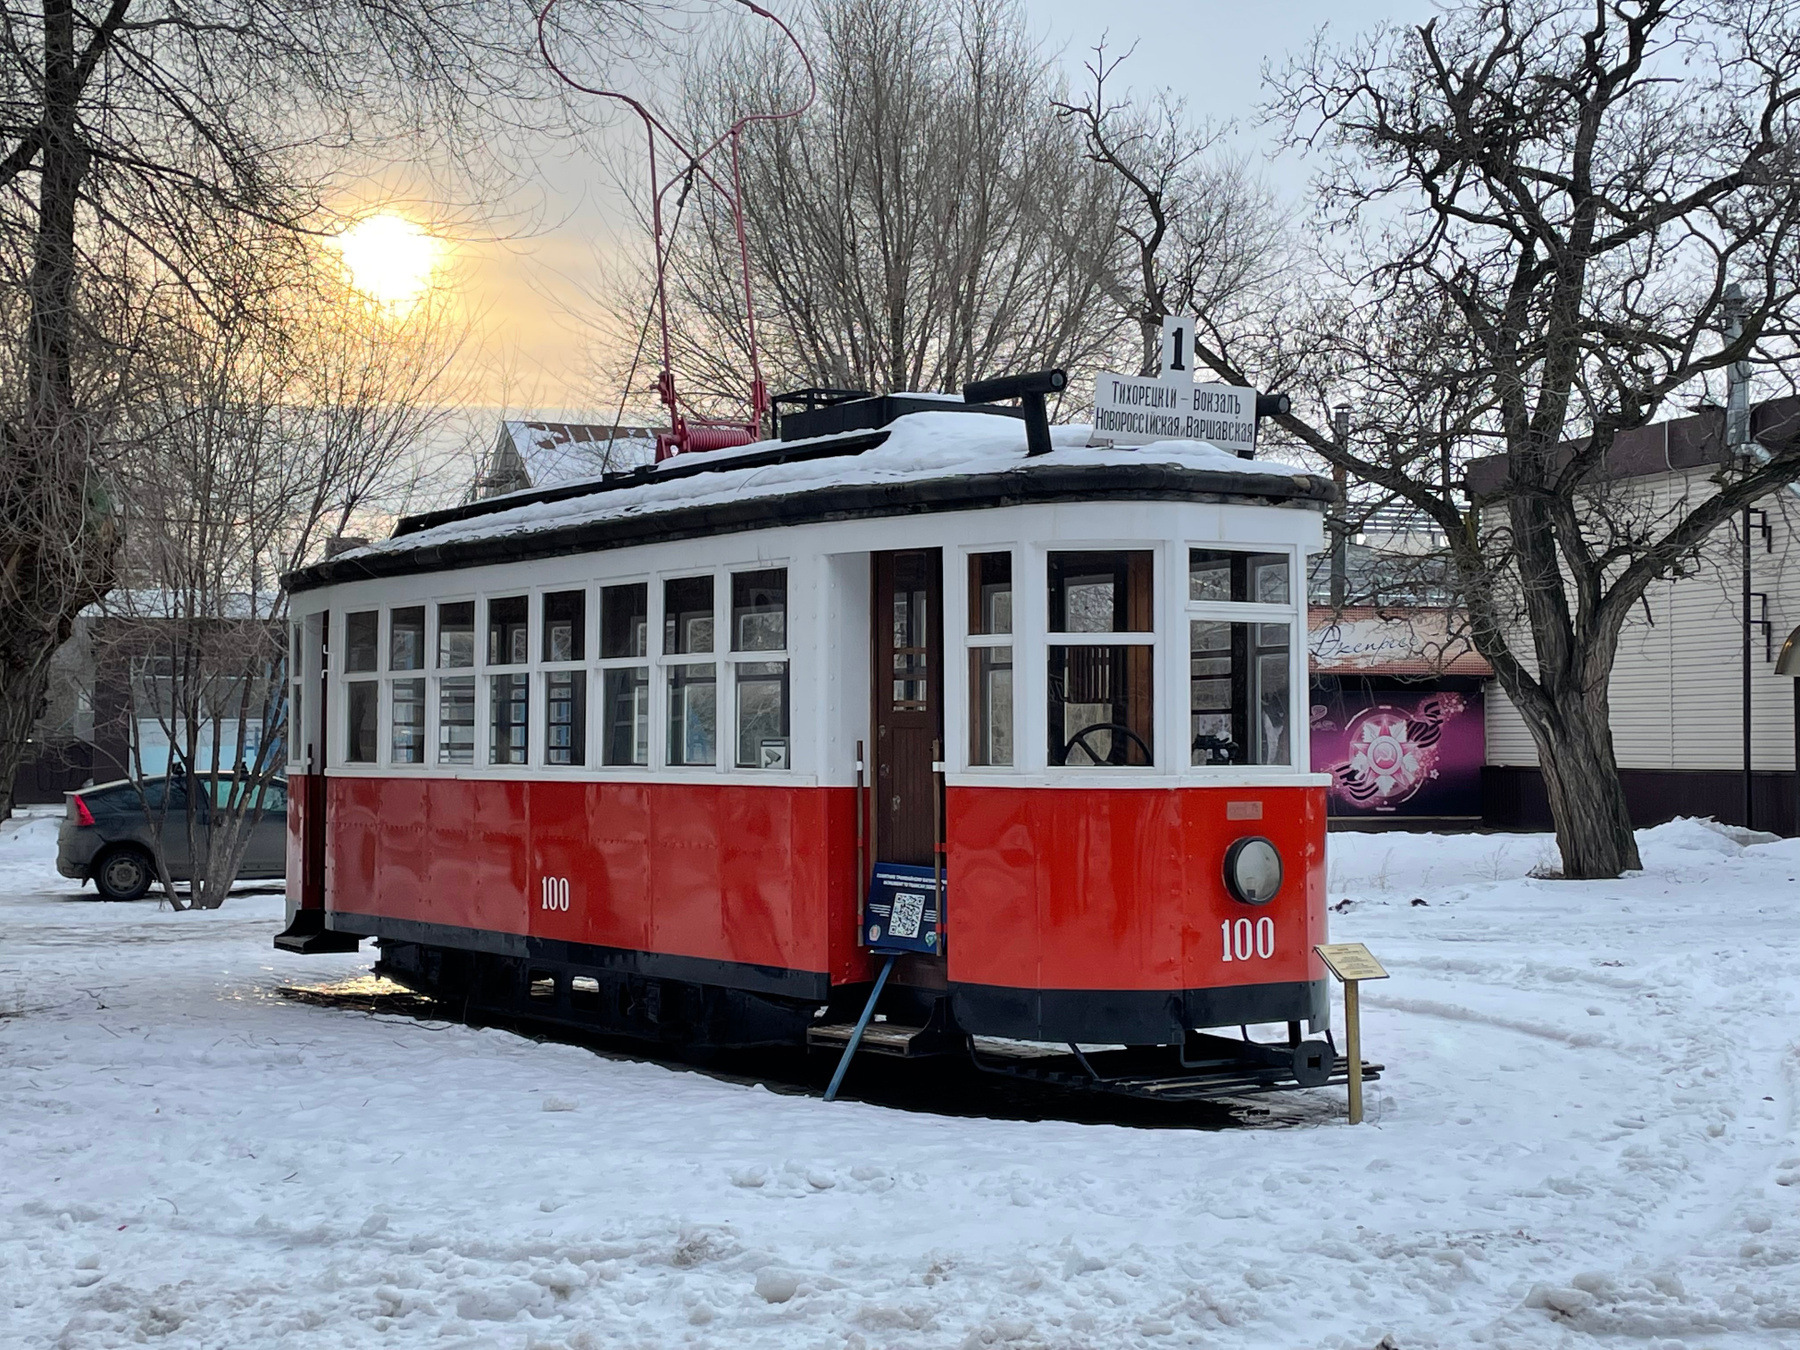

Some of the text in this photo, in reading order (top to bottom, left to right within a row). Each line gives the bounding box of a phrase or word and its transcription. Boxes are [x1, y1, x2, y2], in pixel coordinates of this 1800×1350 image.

[1170, 327, 1185, 371] 1
[541, 876, 570, 912] 100
[1221, 916, 1275, 962] 100
